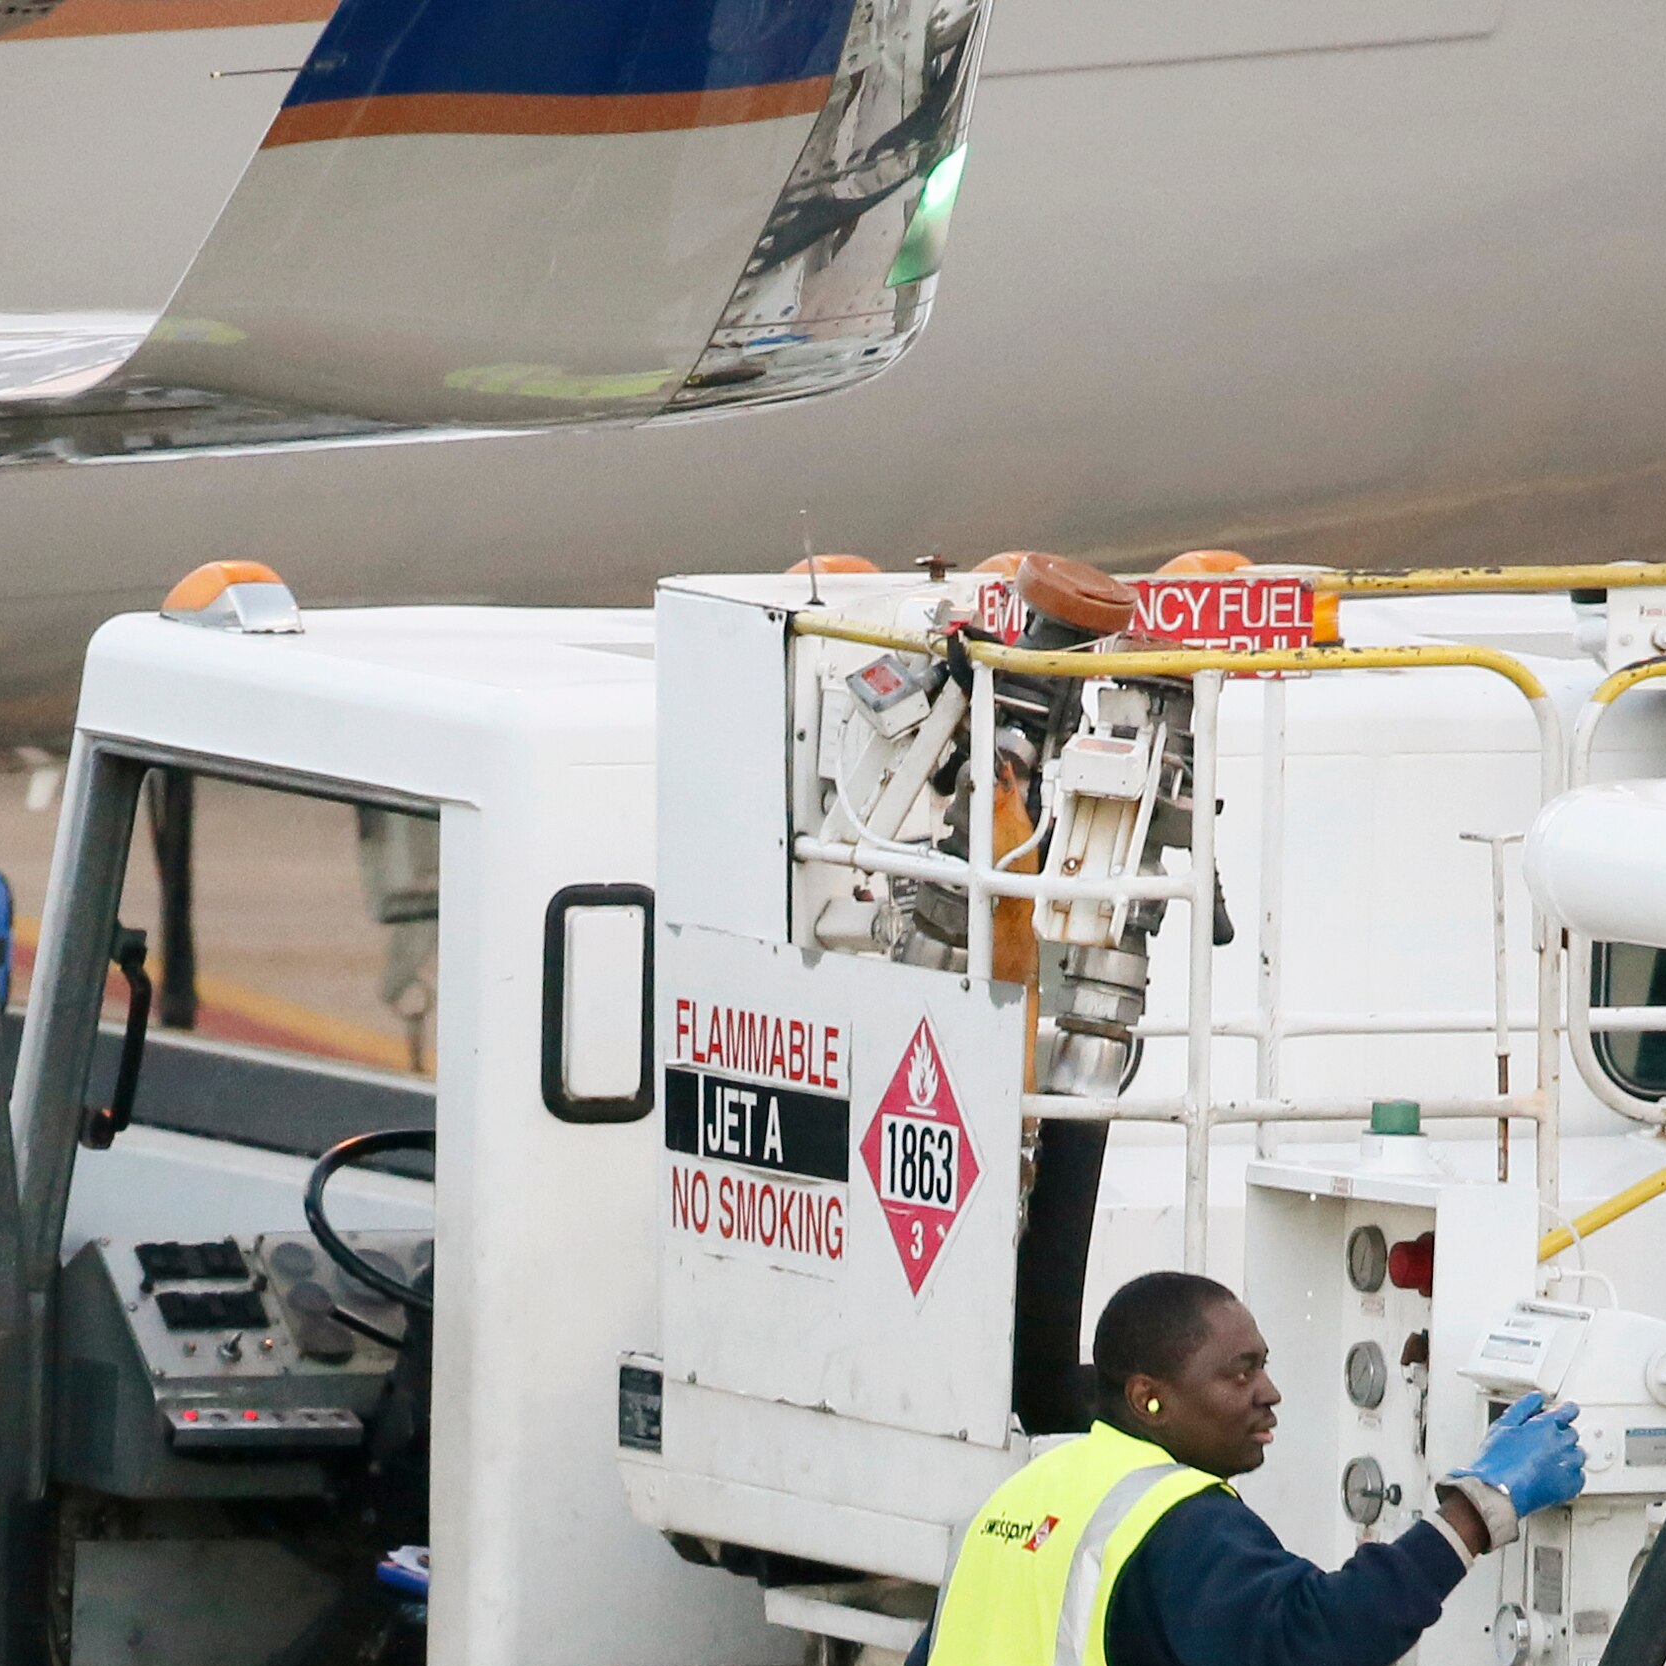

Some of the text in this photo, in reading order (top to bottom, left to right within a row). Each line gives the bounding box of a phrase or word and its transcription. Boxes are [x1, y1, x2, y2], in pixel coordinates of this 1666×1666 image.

[1218, 586, 1313, 631] FUEL
[676, 999, 839, 1089] FLAMMABLE
[707, 1086, 784, 1163] JET A
[887, 1121, 954, 1204] 1863
[672, 1166, 843, 1260] NO SMOKING
[910, 1219, 925, 1260] 3
